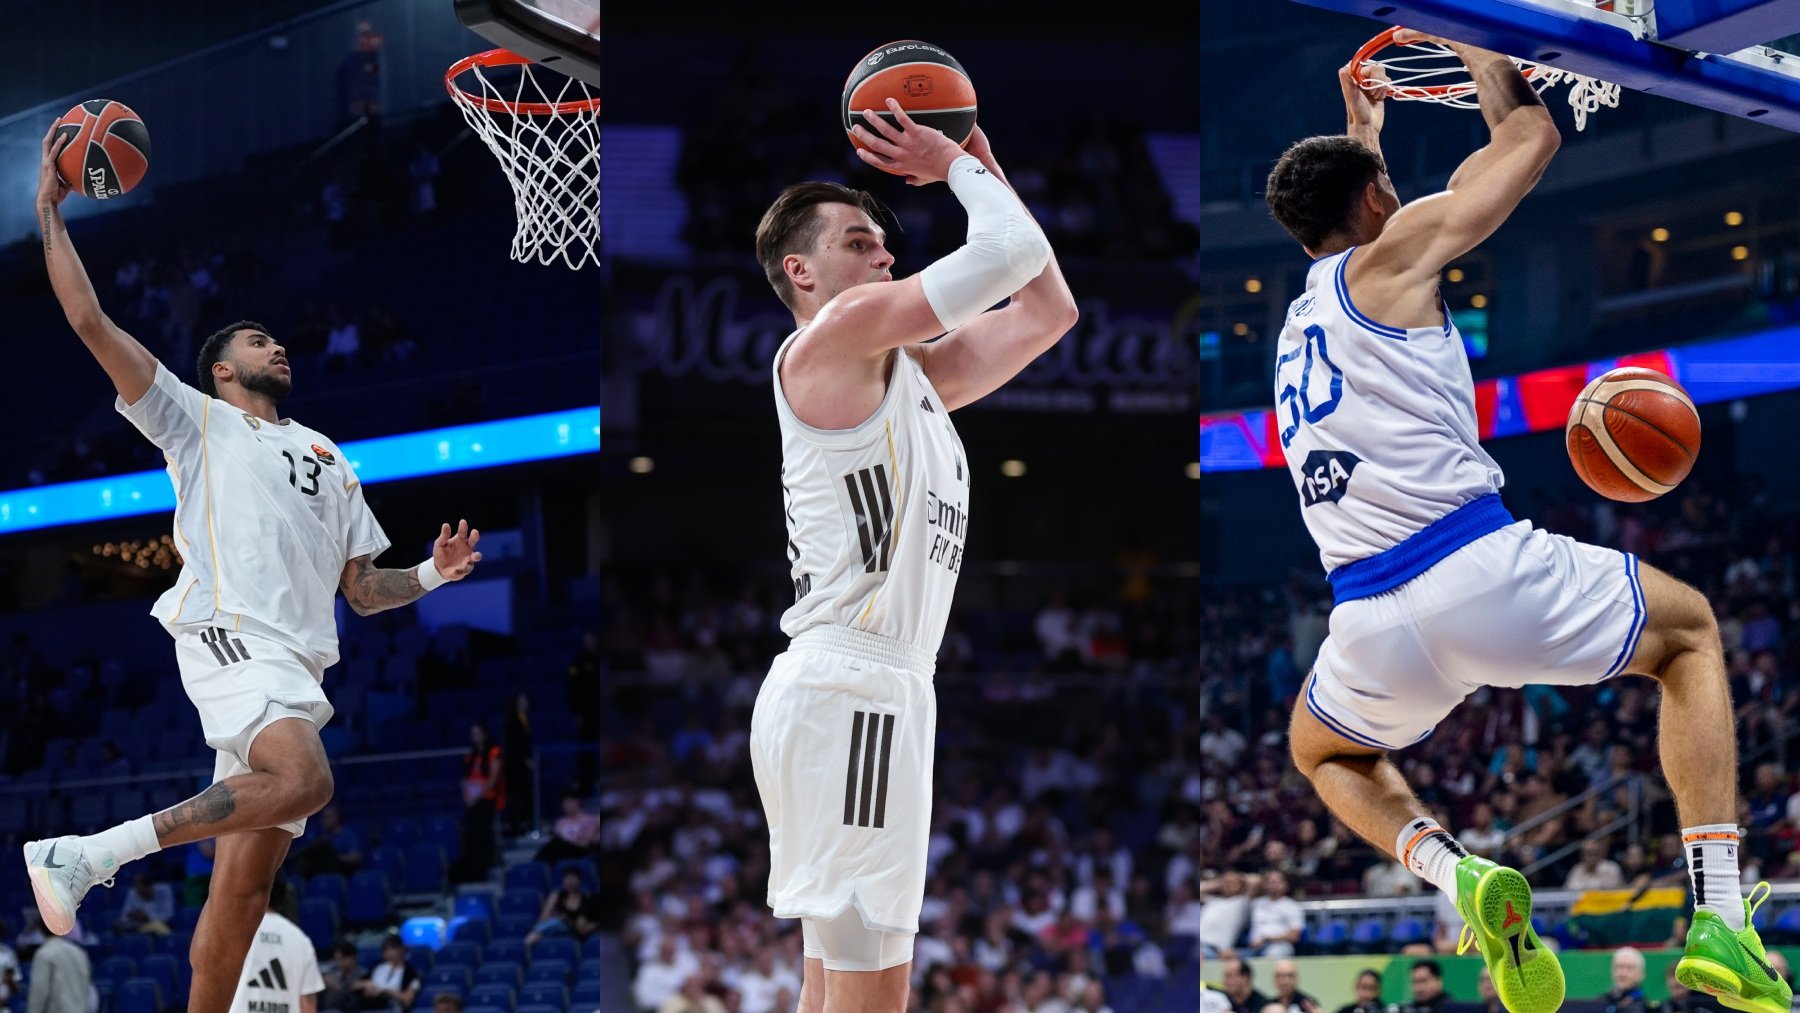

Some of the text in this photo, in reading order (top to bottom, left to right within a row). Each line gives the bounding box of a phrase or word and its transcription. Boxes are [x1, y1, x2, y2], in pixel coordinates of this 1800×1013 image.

[87, 167, 109, 200] SPALD
[1276, 323, 1344, 450] 50
[282, 449, 322, 497] 13
[927, 489, 969, 546] Emir
[929, 533, 963, 575] FLY BE
